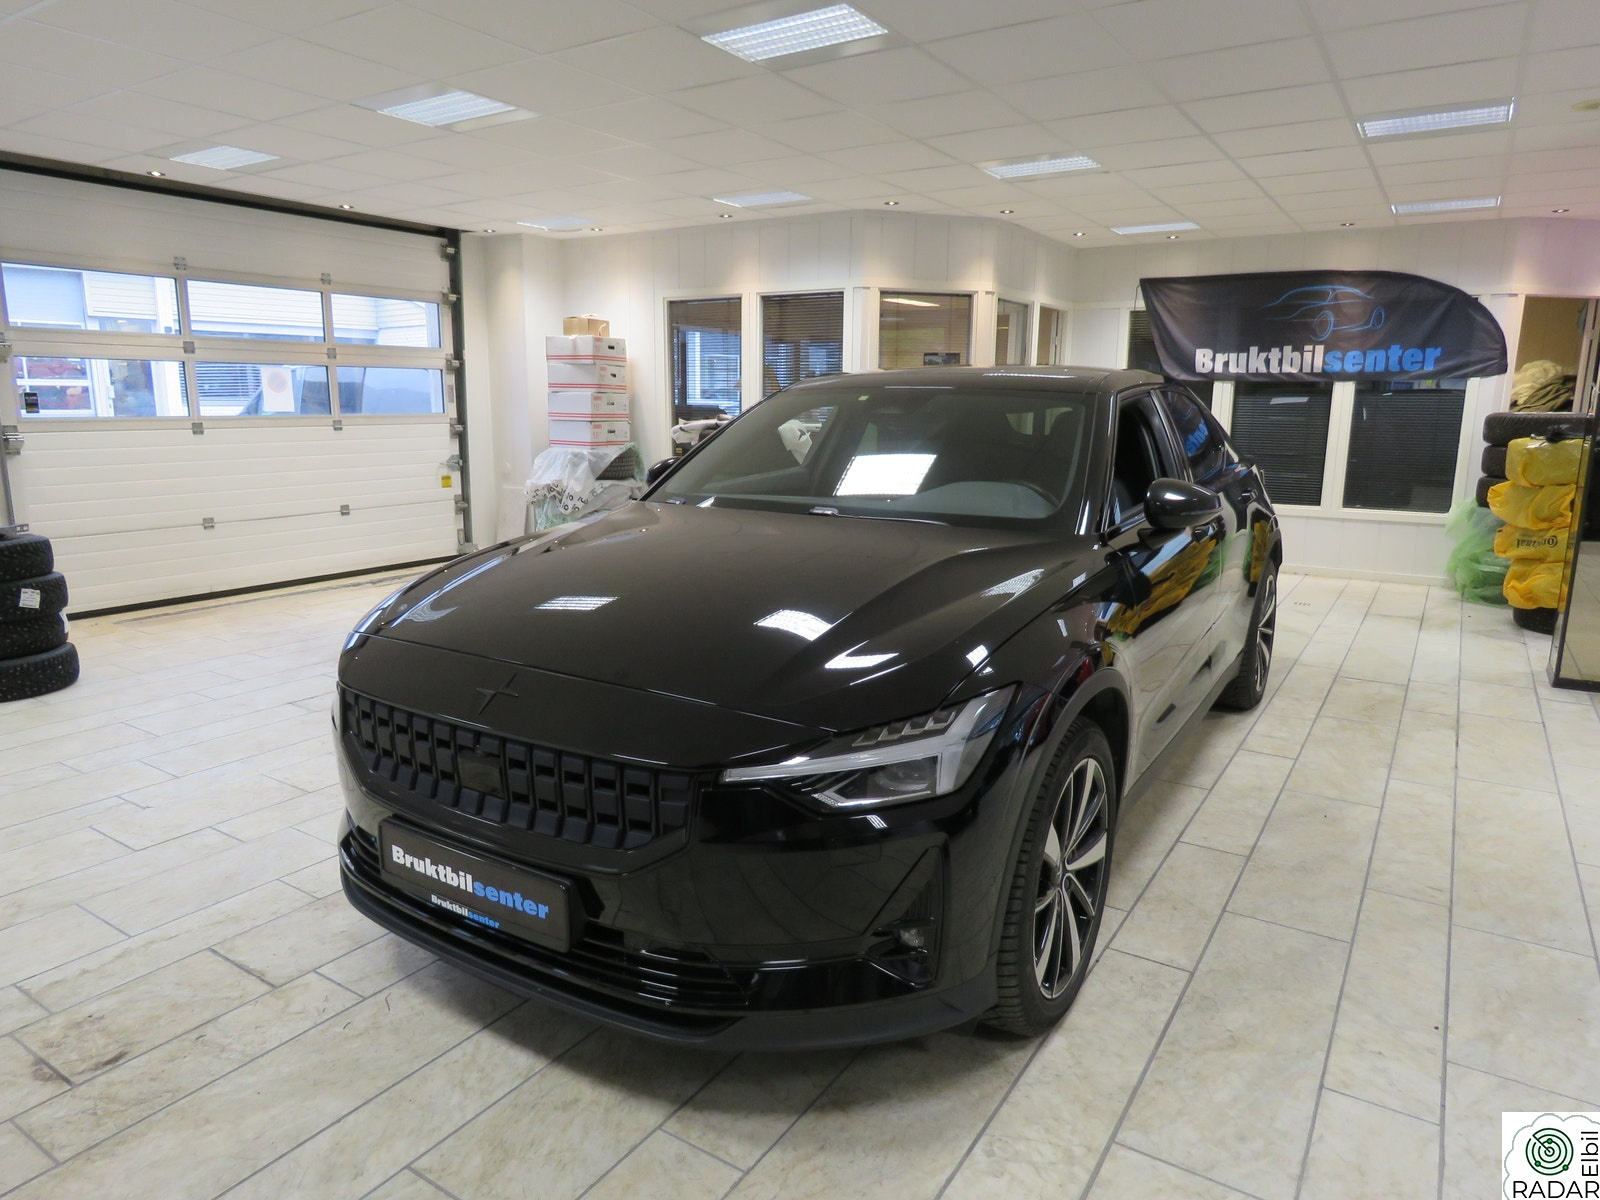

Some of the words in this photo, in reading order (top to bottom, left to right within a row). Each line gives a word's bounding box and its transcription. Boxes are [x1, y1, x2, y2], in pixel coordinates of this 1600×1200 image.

[1195, 344, 1442, 374] Bruktbilsenter
[391, 844, 549, 920] Bruktbilsenter
[431, 894, 500, 929] Bruktbilsenter
